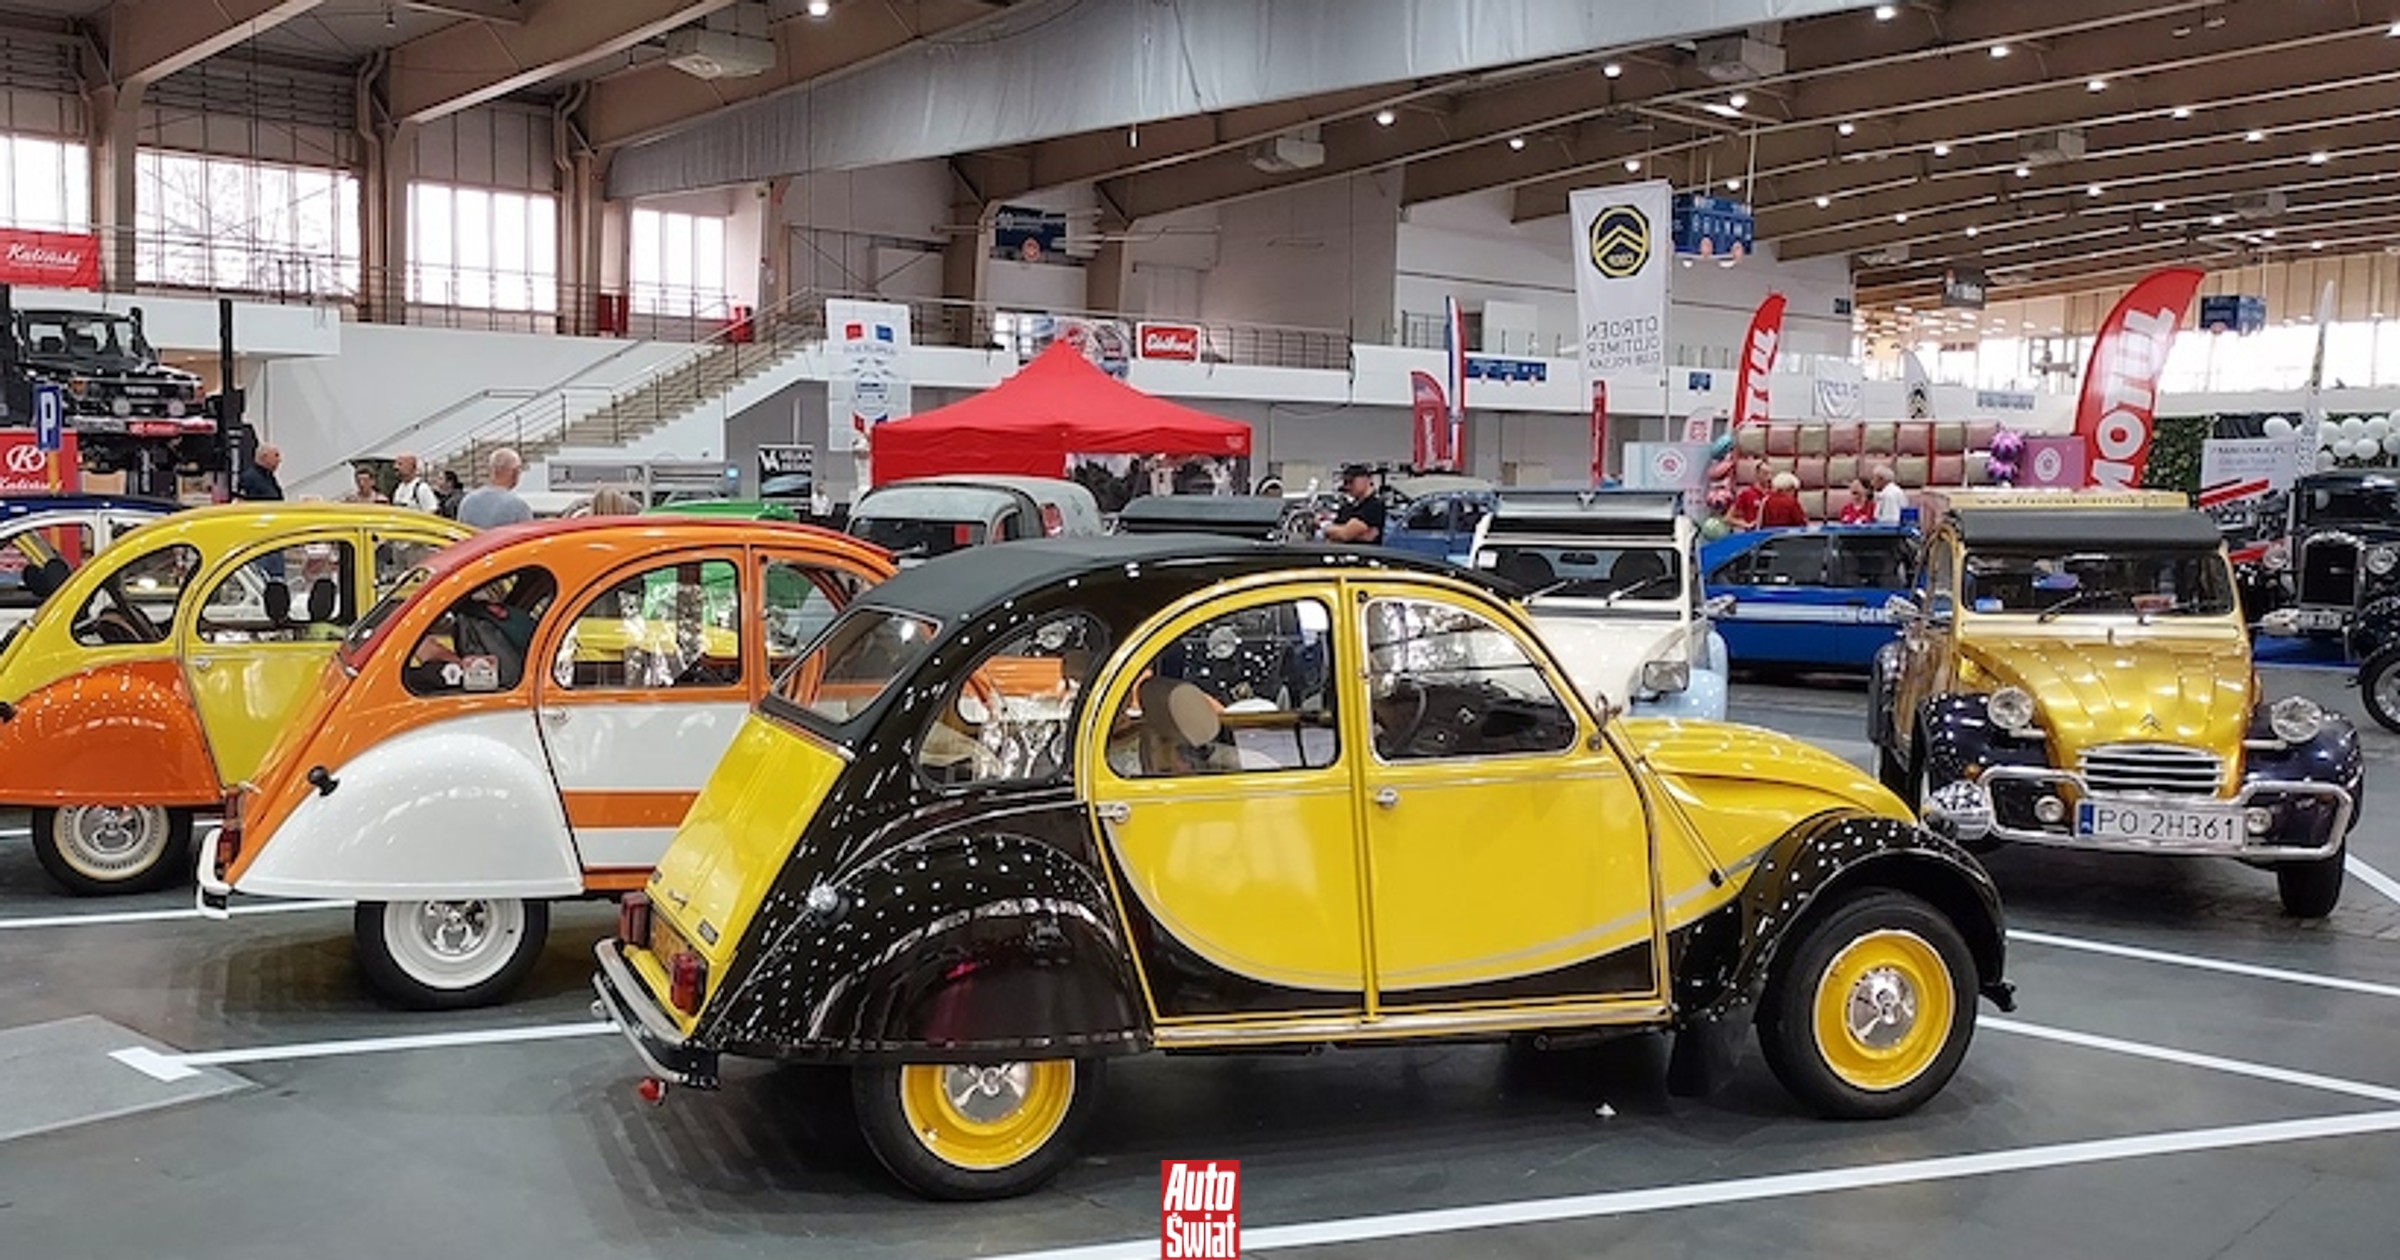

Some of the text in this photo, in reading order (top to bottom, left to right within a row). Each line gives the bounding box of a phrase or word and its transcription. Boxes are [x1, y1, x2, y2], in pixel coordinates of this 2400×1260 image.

[40, 391, 58, 448] P
[2091, 306, 2176, 492] MOTUL
[2099, 809, 2233, 841] PO 2H361
